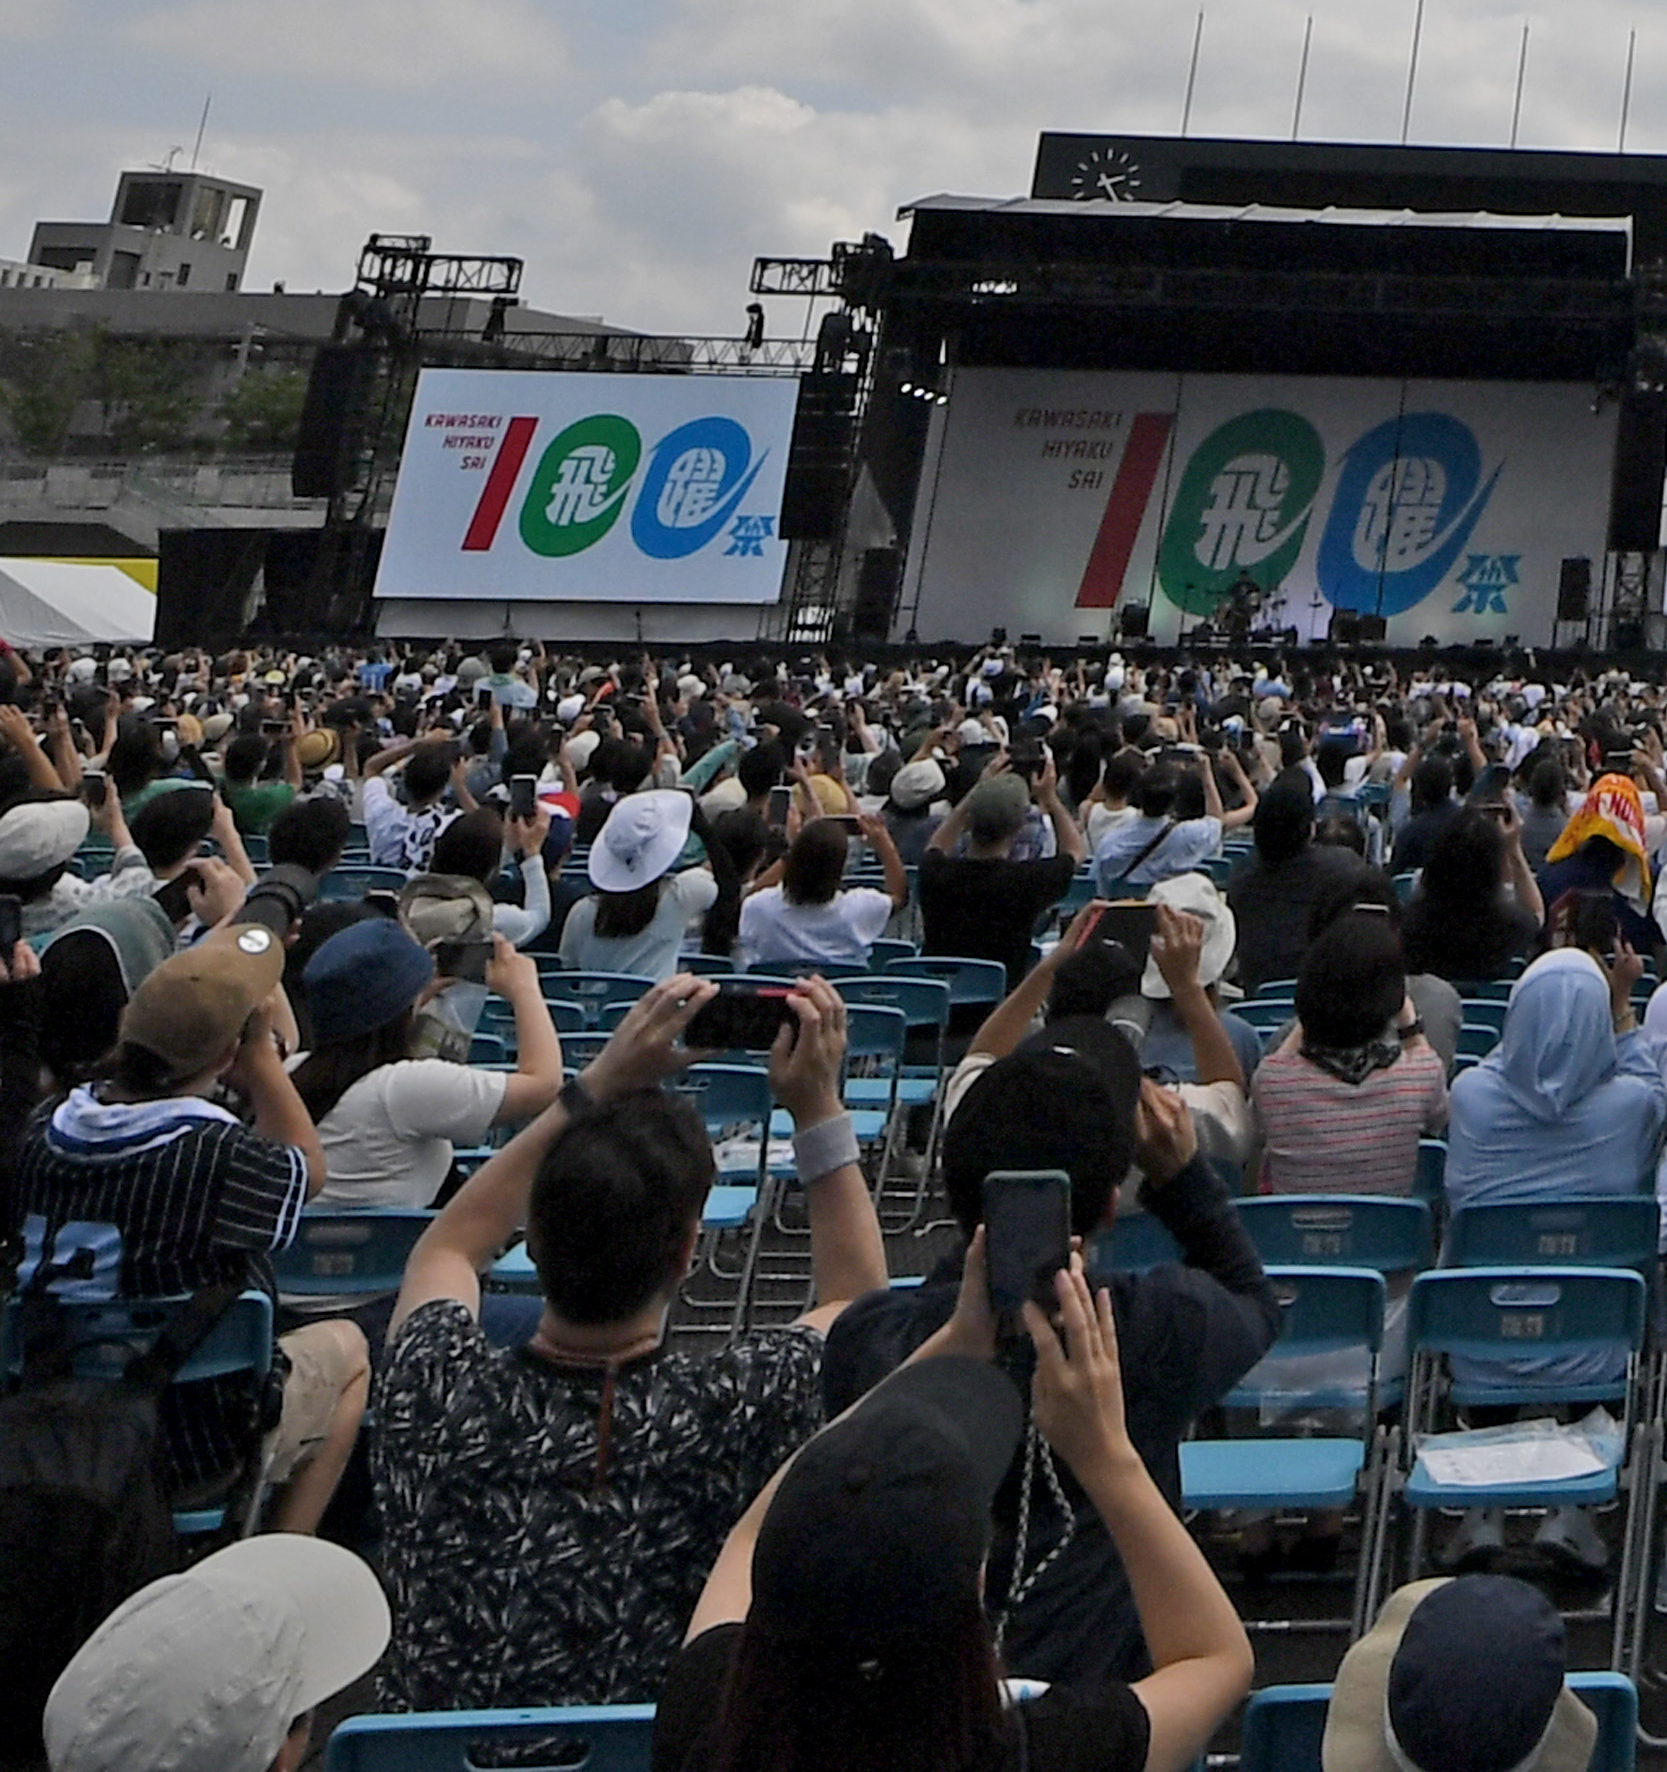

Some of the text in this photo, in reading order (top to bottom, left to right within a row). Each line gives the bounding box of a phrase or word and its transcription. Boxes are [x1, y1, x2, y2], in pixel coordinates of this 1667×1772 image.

[425, 414, 502, 428] KAWASAKI
[1014, 409, 1122, 428] KAWASAKI
[442, 435, 495, 449] HIYAKU
[1041, 440, 1113, 459] HIYAKU
[460, 456, 487, 470] SAI
[461, 414, 770, 559] 100
[1068, 469, 1103, 489] SAI
[1075, 408, 1506, 617] 100
